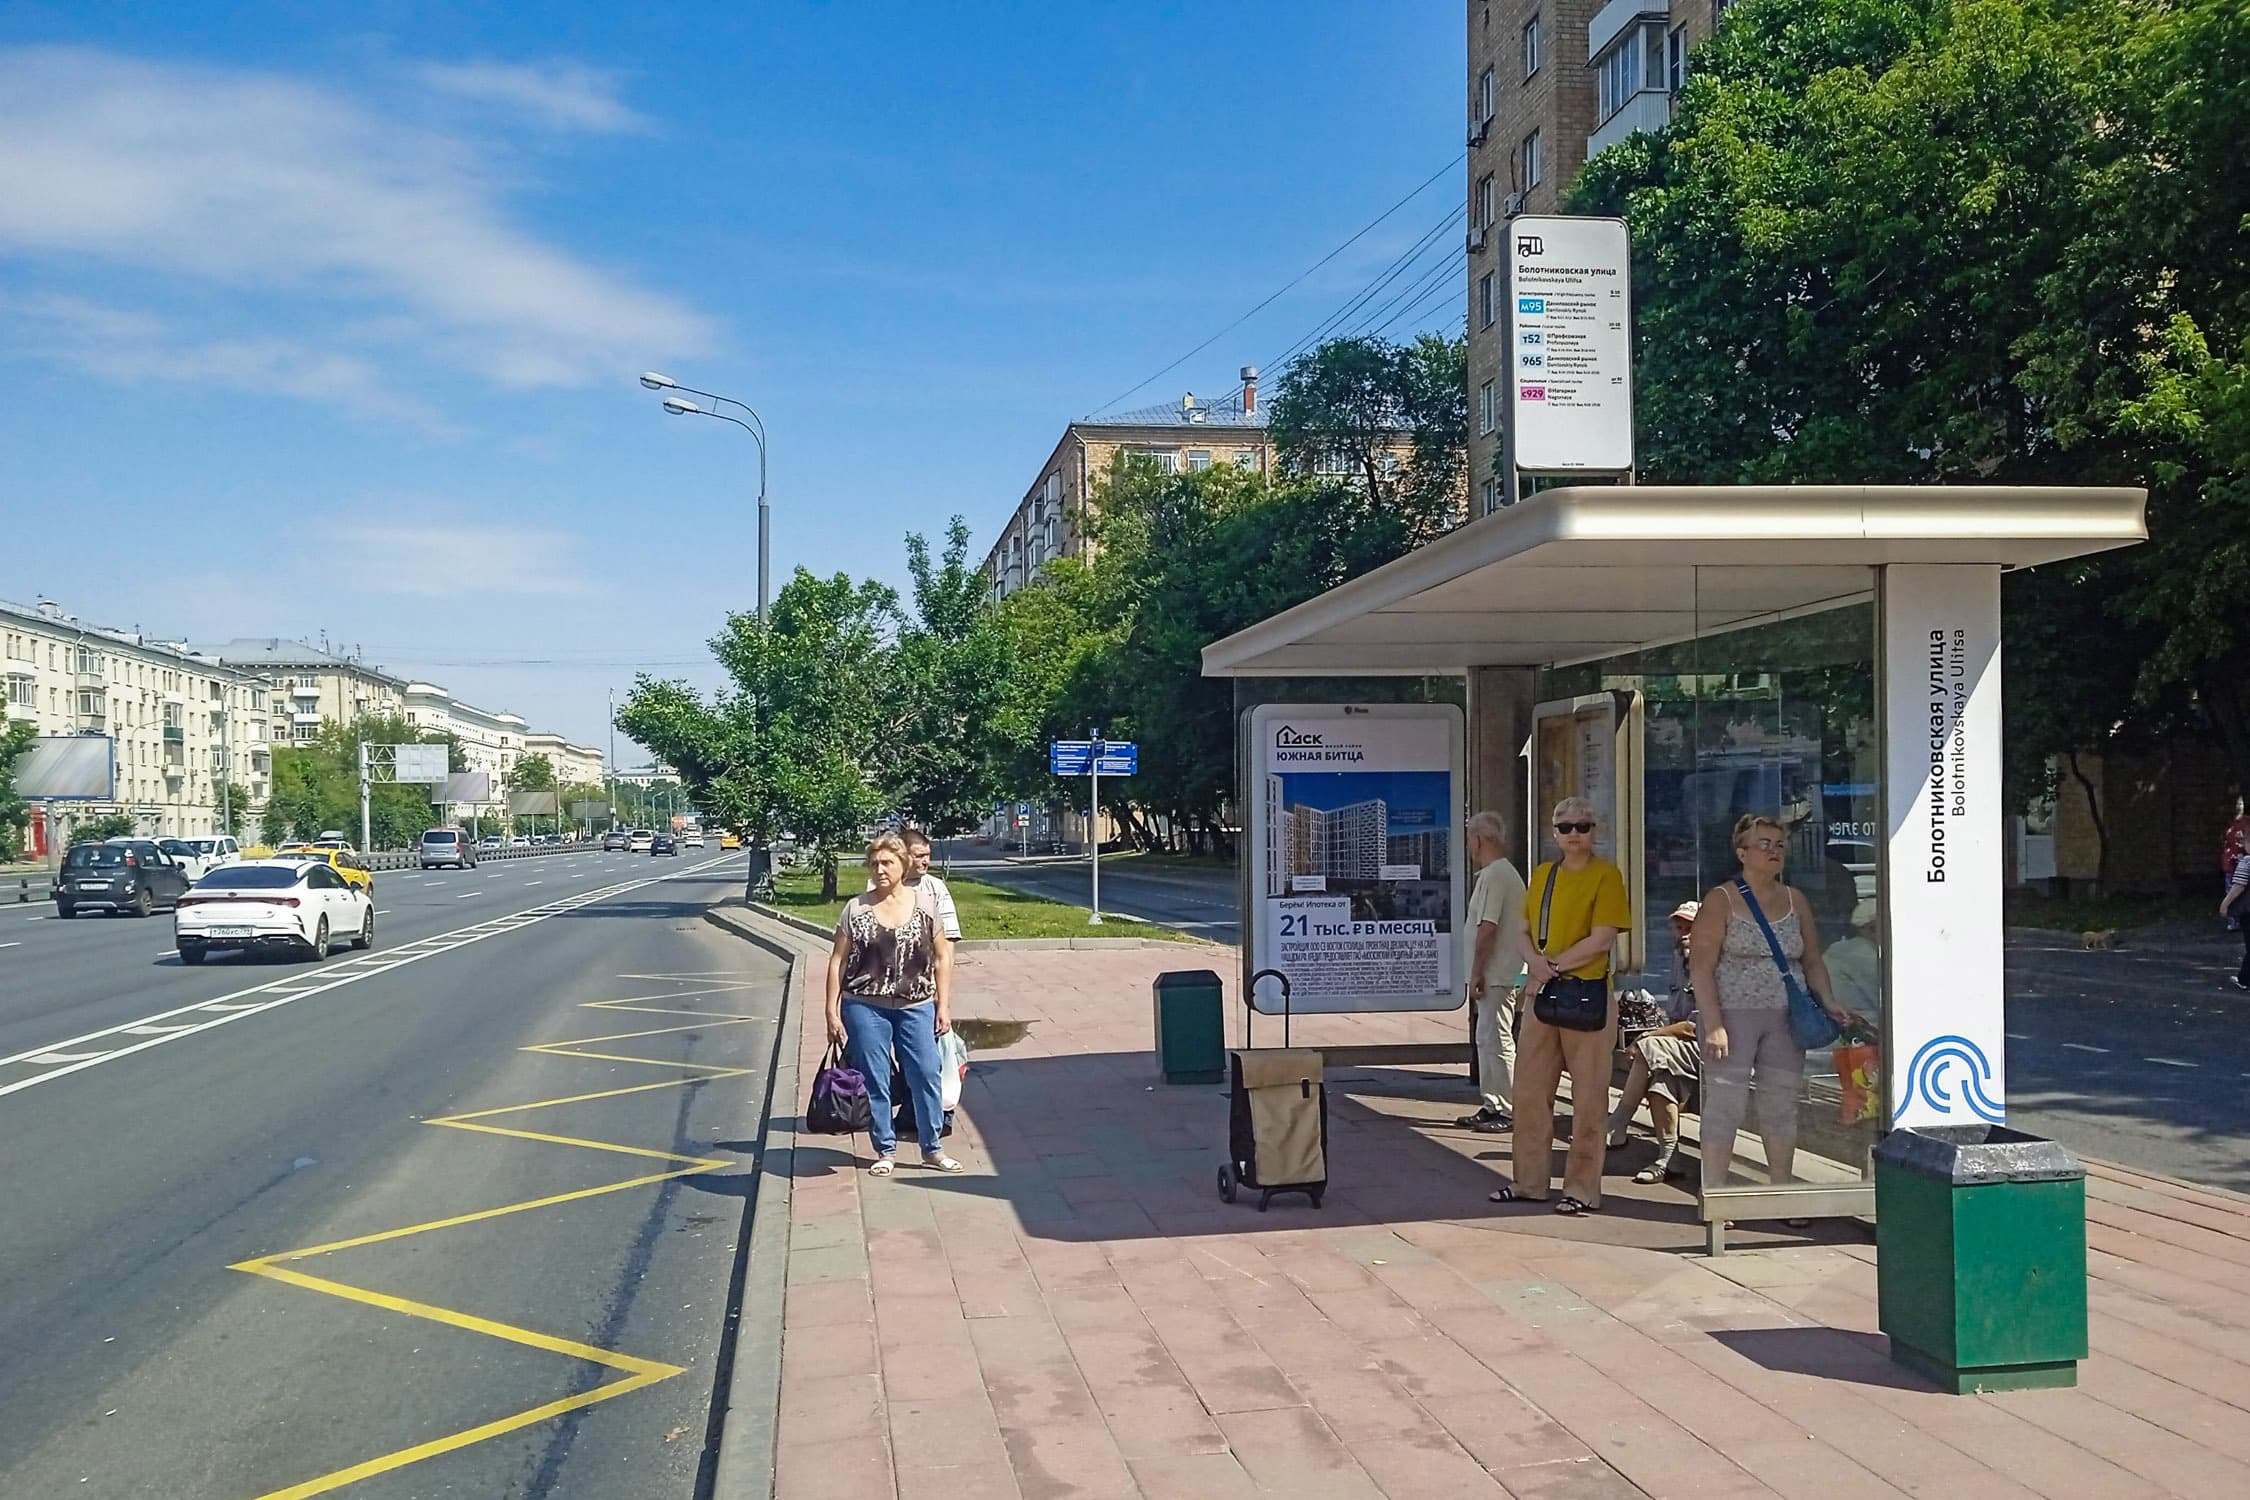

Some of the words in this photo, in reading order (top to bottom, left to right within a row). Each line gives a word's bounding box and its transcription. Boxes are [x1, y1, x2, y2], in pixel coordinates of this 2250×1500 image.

[1519, 265, 1589, 275] Болотниковская
[1590, 267, 1617, 277] улица
[1522, 357, 1542, 366] 965
[1930, 629, 1948, 695] улица
[1951, 629, 1965, 677] Ulitsa
[1276, 751, 1322, 761] ЮЖНАЯ
[1325, 751, 1364, 763] БИТЦА
[1951, 682, 1968, 817] Bolotnikovskaya
[1927, 700, 1946, 883] Болотниковская
[1306, 901, 1336, 909] Ипотека
[1280, 914, 1307, 936] 21
[1313, 924, 1350, 936] тыс.
[1365, 923, 1375, 934] в
[1379, 922, 1433, 937] месяц
